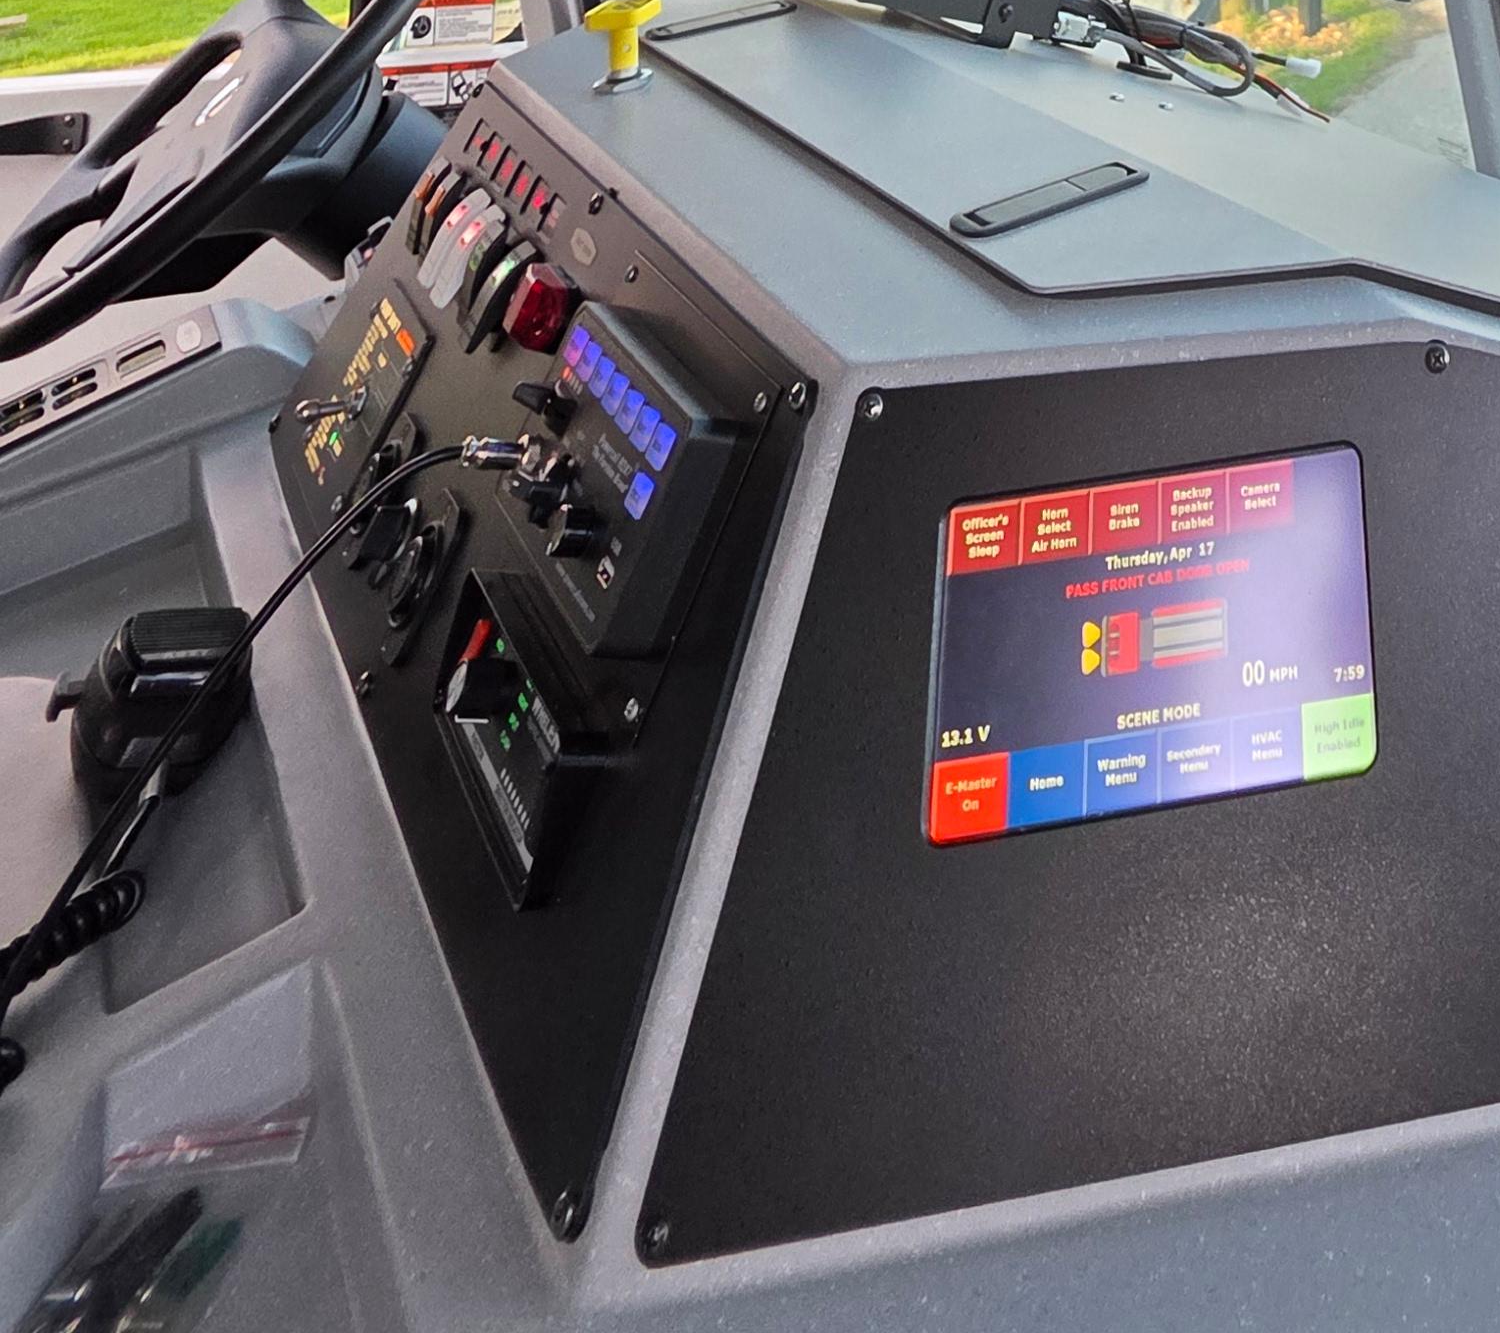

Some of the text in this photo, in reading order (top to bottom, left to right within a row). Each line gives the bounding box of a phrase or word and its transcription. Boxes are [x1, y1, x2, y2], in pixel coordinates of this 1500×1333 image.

[1172, 486, 1212, 502] Backup
[1240, 483, 1281, 497] Camera
[1110, 503, 1139, 517] Siren
[1170, 501, 1214, 517] Speaker
[1244, 495, 1277, 510] Select
[962, 514, 1009, 531] Officer's
[1042, 508, 1068, 521] Horn
[1037, 520, 1072, 536] Select
[1108, 517, 1140, 531] Brake
[1171, 515, 1214, 532] Enabled
[965, 530, 1004, 545] Screen
[1031, 537, 1077, 553] Air Horn
[968, 545, 1000, 559] Sleep
[1105, 541, 1215, 571] Thursday, Apr 17
[1065, 581, 1099, 599] PASS
[1102, 574, 1145, 593] FRONT
[1148, 571, 1173, 585] CAB
[1216, 559, 1250, 575] OPEN
[1242, 659, 1299, 687] 00 MPH
[1333, 664, 1366, 683] 7:59
[1116, 703, 1201, 730] SCENE MODE
[941, 725, 991, 748] 13.1 V
[1251, 729, 1282, 745] HVAC
[1317, 735, 1361, 754] Enabled
[1166, 742, 1222, 763] Secondary
[1252, 747, 1283, 763] Menu
[1097, 753, 1146, 773] Warning
[1180, 758, 1209, 774] Menu
[945, 776, 998, 795] E-Master
[1029, 775, 1064, 791] Home
[1105, 771, 1137, 787] Menu
[962, 799, 979, 812] On
